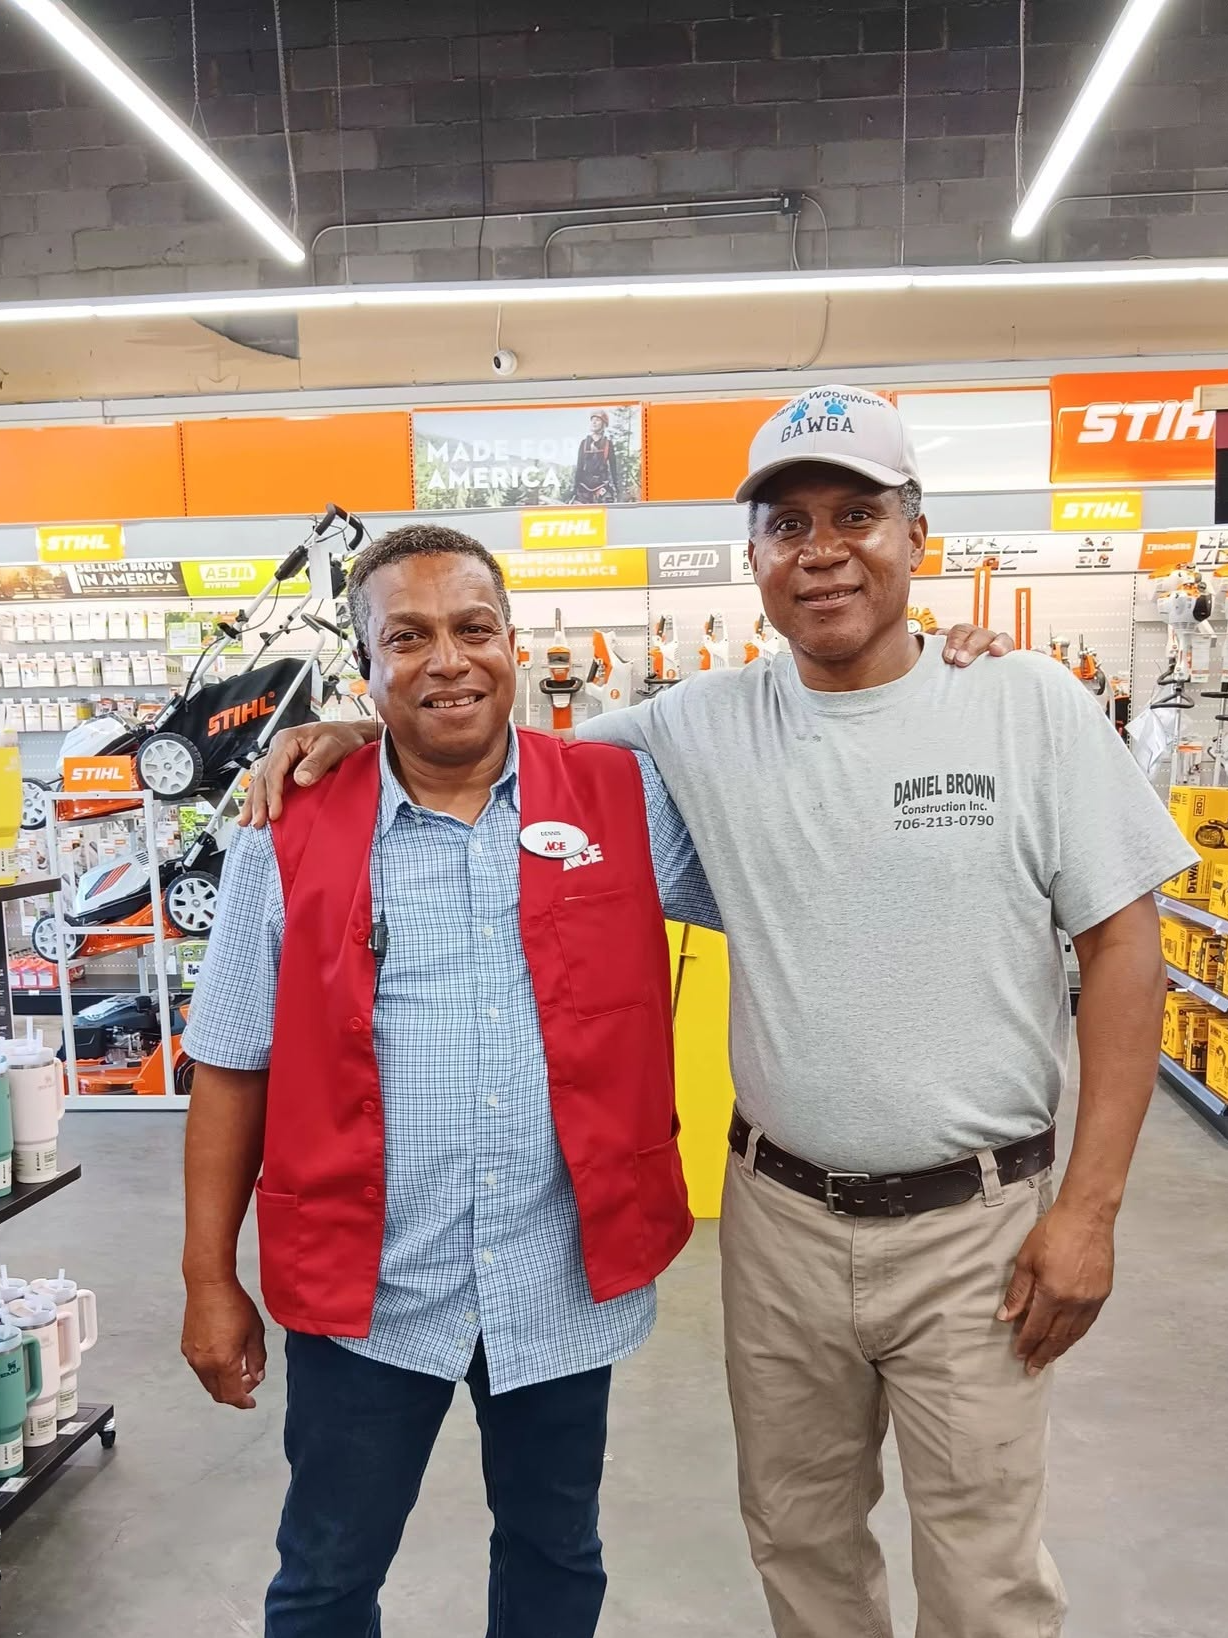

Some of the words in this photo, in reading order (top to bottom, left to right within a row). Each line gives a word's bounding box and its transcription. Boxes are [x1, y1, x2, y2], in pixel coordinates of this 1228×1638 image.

[781, 416, 855, 443] GAWGA
[427, 440, 509, 463] MADE
[428, 466, 562, 490] AMERICA
[1061, 501, 1135, 519] STIHL
[529, 519, 598, 538] STIHL
[47, 534, 110, 550] STIHL
[76, 562, 129, 573] SELLING
[130, 561, 173, 572] BRAND
[508, 566, 618, 578] PERFORMANCE
[659, 570, 700, 578] SYSTEM
[78, 574, 99, 586] IN
[100, 572, 178, 586] AMERICA
[207, 697, 276, 737] STIHL
[71, 767, 124, 781] STIHL
[893, 775, 943, 808] DANIEL
[946, 773, 996, 802] BROWN
[902, 801, 966, 815] Construction
[969, 801, 988, 811] Inc.
[893, 815, 995, 831] 706-213-0790
[544, 841, 567, 851] ACE
